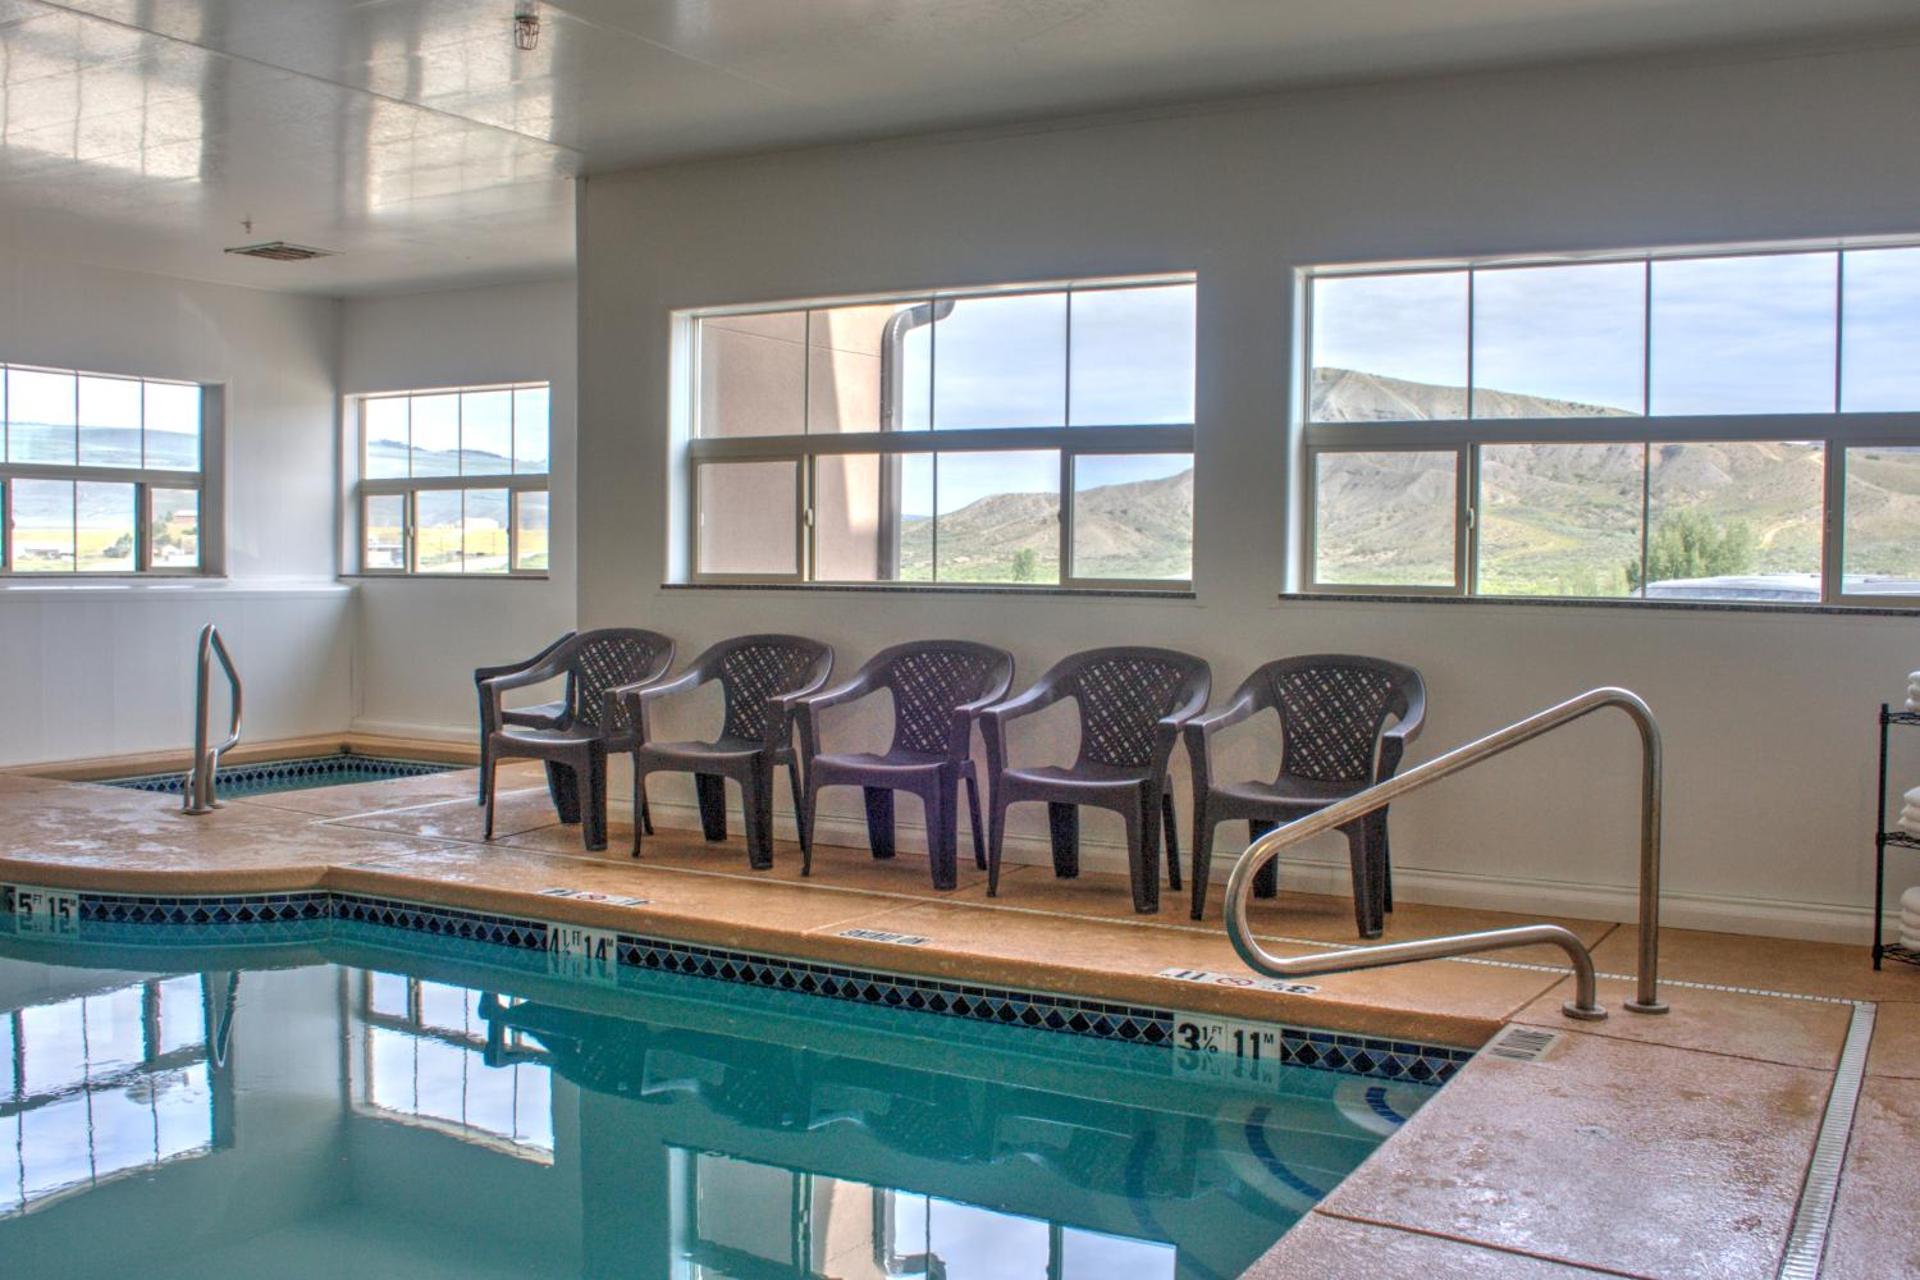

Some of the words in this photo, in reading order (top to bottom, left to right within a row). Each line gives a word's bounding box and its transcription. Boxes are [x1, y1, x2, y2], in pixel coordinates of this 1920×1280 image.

[19, 892, 33, 914] 5
[49, 896, 70, 918] 15
[584, 935, 606, 961] 14
[1233, 1029, 1260, 1060] 11
[1263, 1032, 1274, 1045] M
